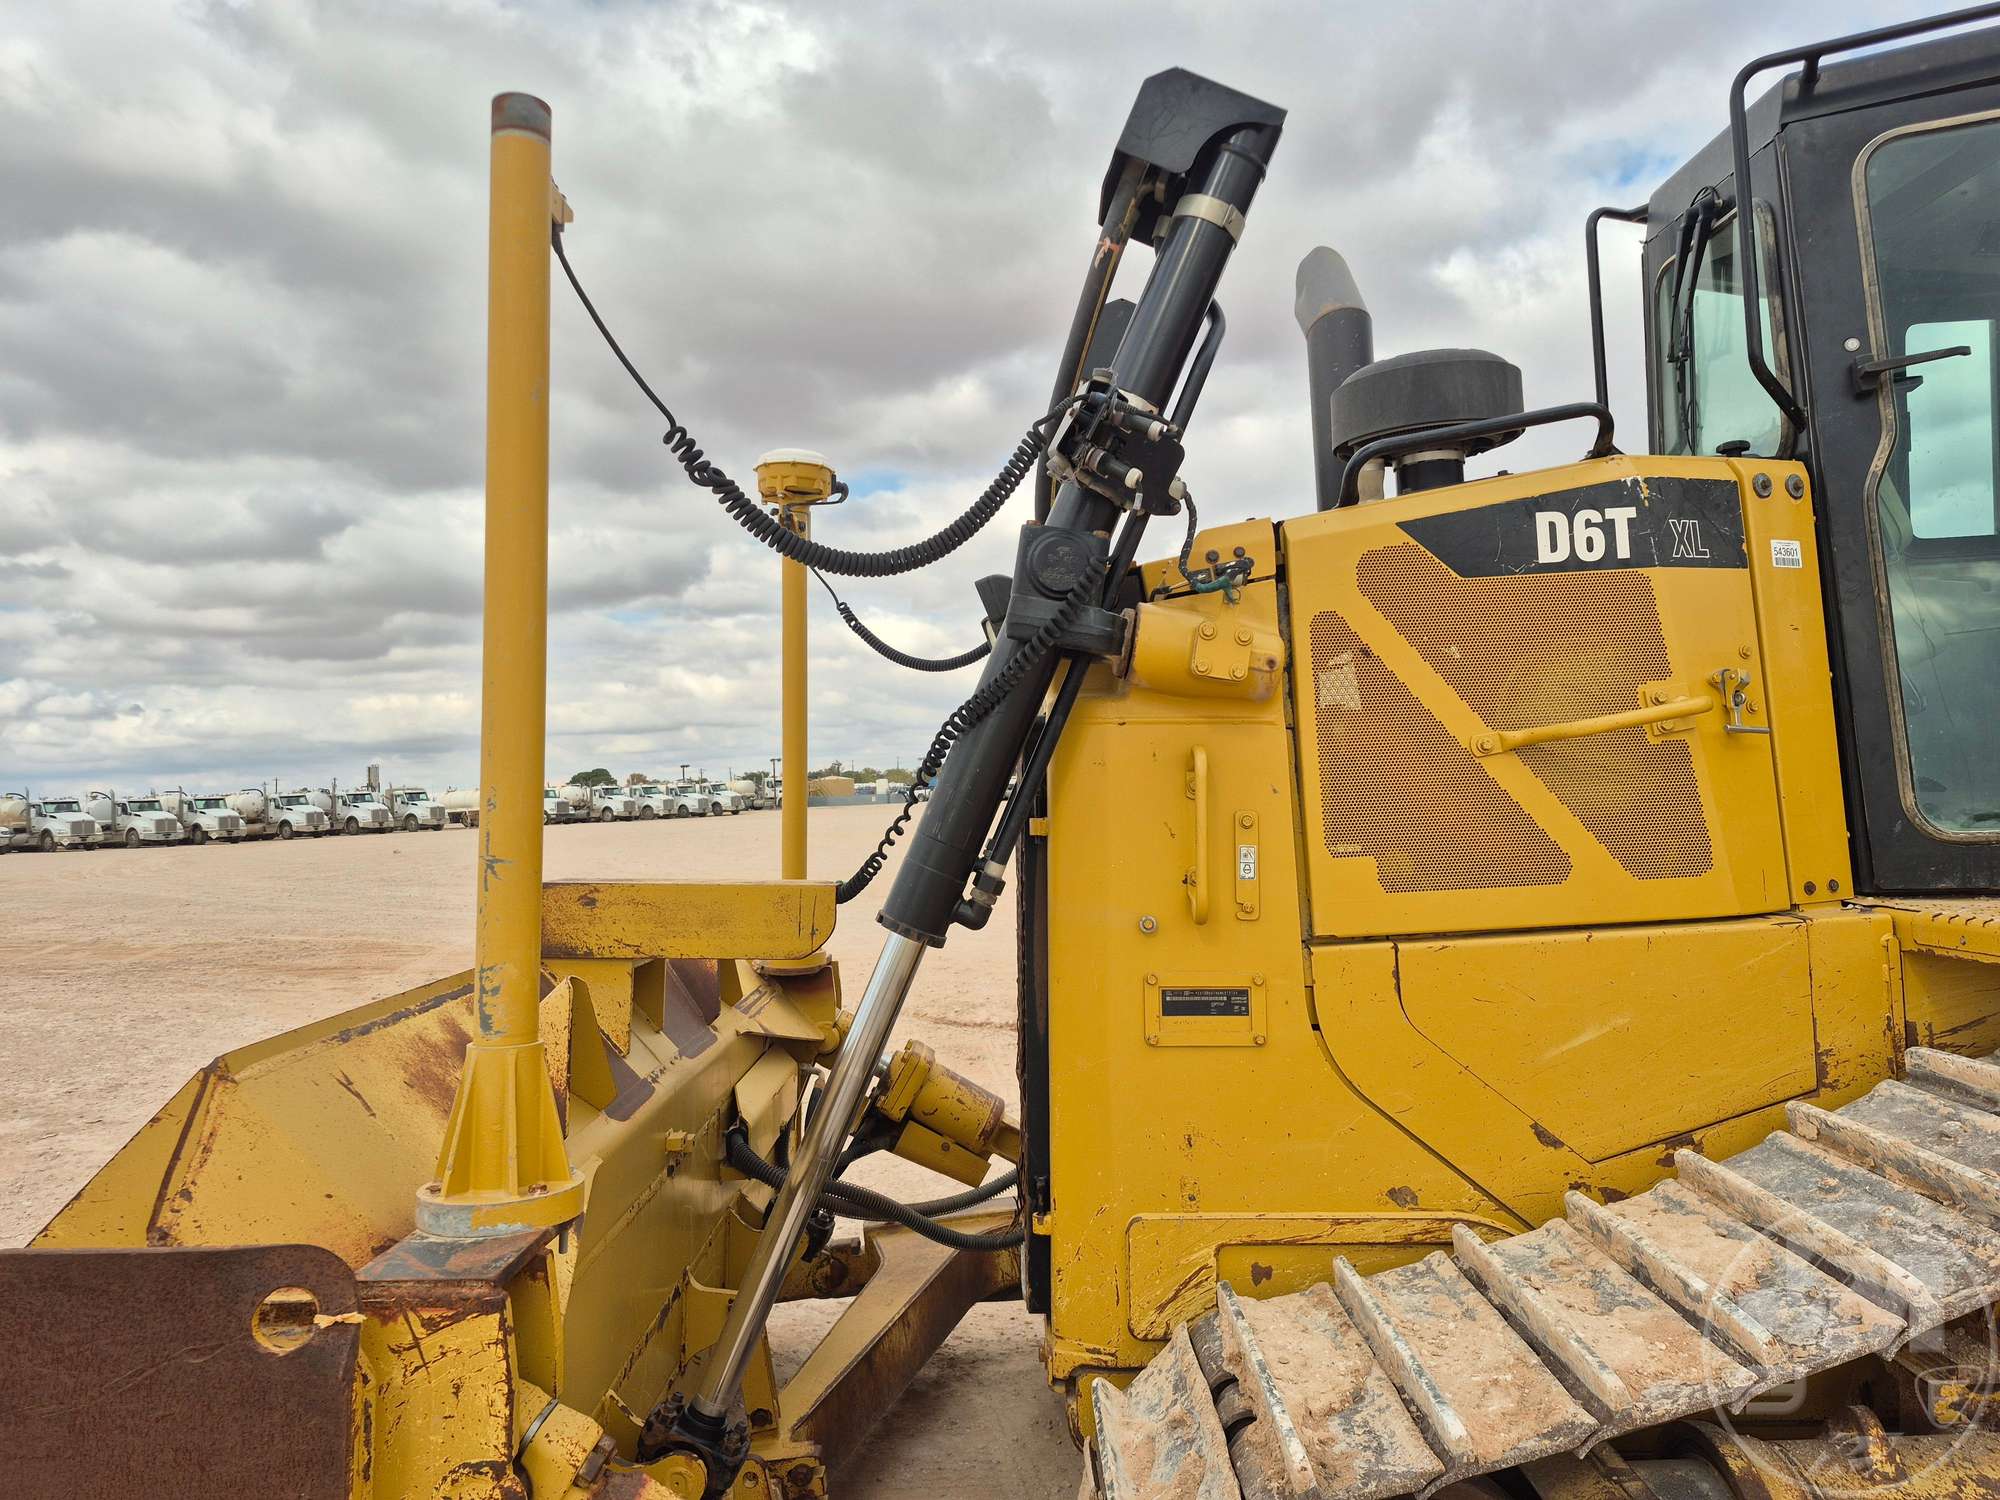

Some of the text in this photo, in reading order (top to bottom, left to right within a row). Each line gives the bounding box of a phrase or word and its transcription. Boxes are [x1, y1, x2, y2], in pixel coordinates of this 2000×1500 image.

[1536, 507, 1710, 564] D6T XL
[1774, 547, 1798, 557] 543601
